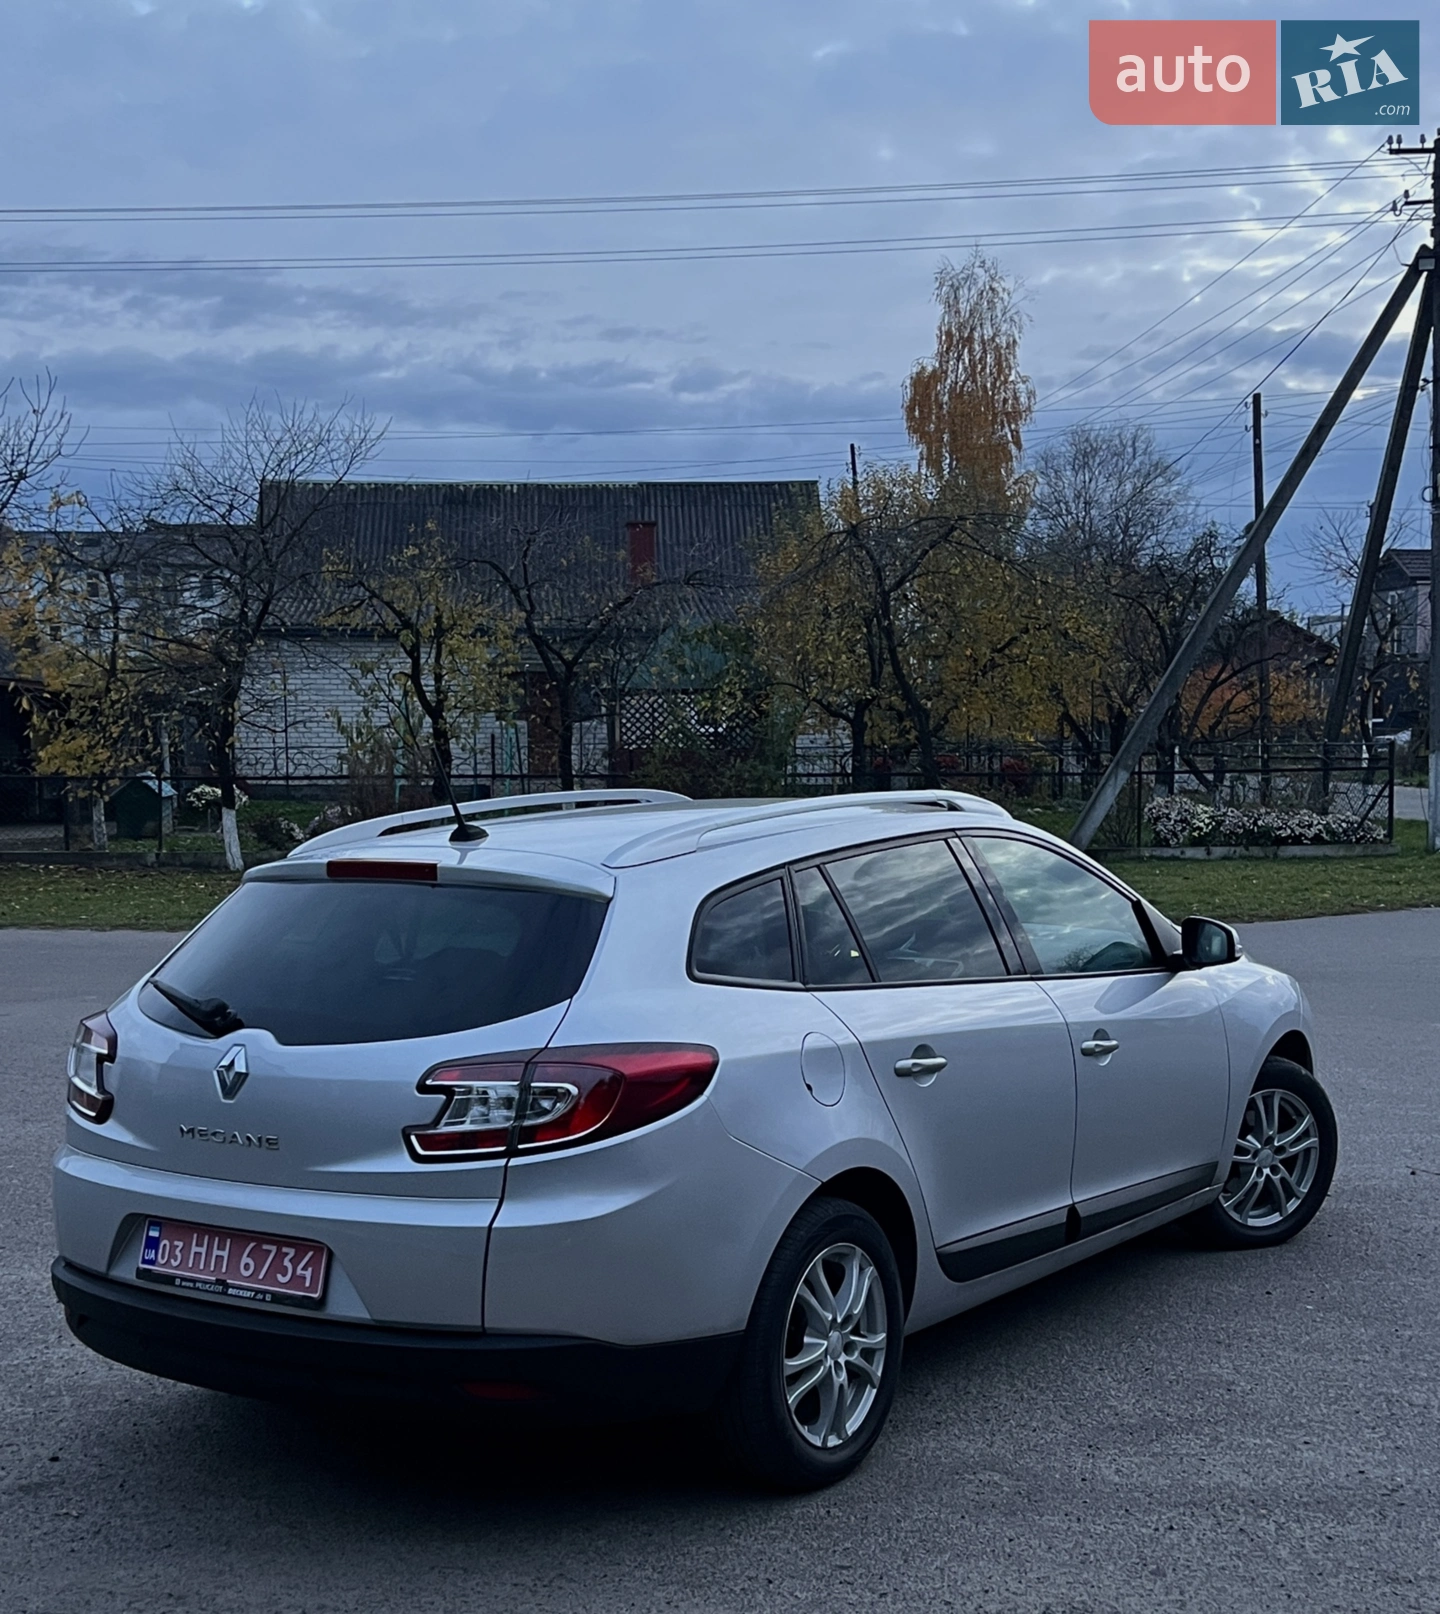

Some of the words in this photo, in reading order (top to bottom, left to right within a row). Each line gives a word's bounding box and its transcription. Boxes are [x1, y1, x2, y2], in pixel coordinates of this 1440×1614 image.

[179, 1124, 280, 1151] MEGANE
[144, 1249, 156, 1261] UA
[157, 1239, 184, 1267] 03
[188, 1233, 231, 1273] HH
[240, 1242, 314, 1288] 6734
